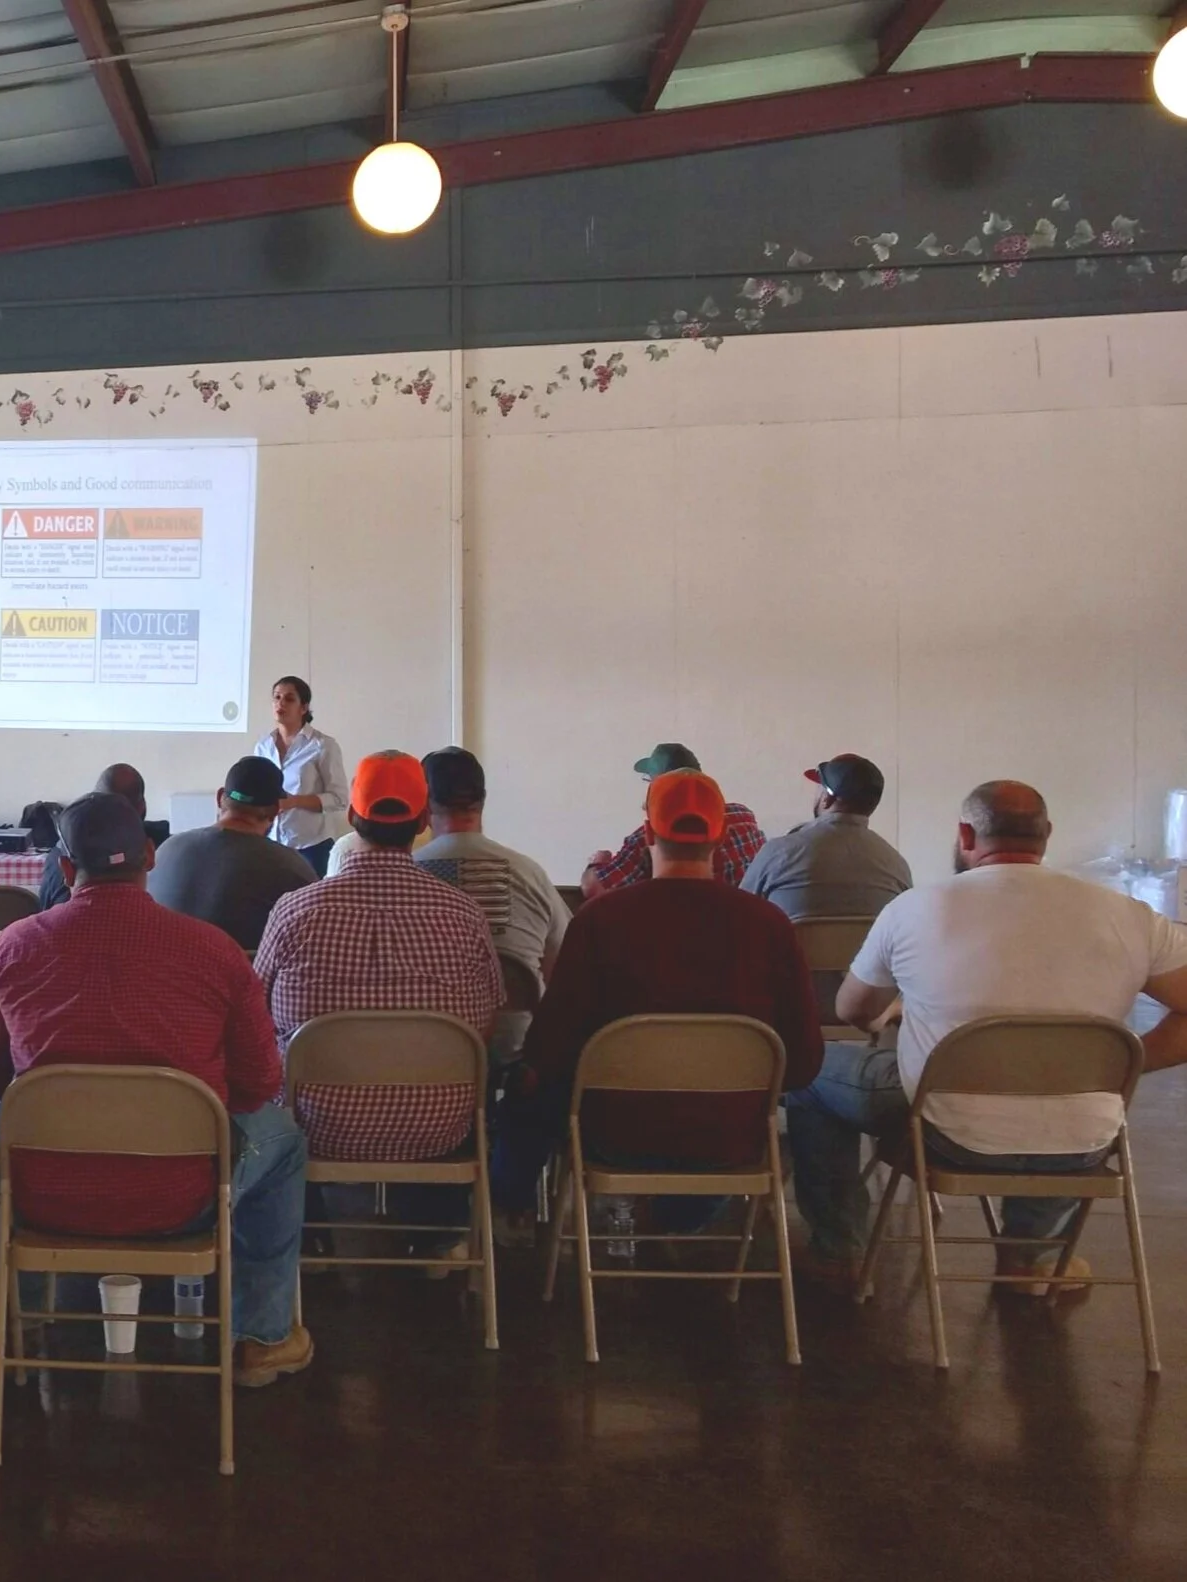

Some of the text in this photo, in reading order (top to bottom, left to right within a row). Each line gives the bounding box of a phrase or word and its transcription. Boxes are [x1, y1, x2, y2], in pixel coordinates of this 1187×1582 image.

[6, 477, 58, 496] Symbols
[60, 476, 82, 491] and
[85, 476, 118, 491] Good
[120, 476, 213, 491] communication
[33, 515, 95, 533] DANGER
[28, 616, 88, 633] CAUTION
[111, 612, 189, 636] NOTICE
